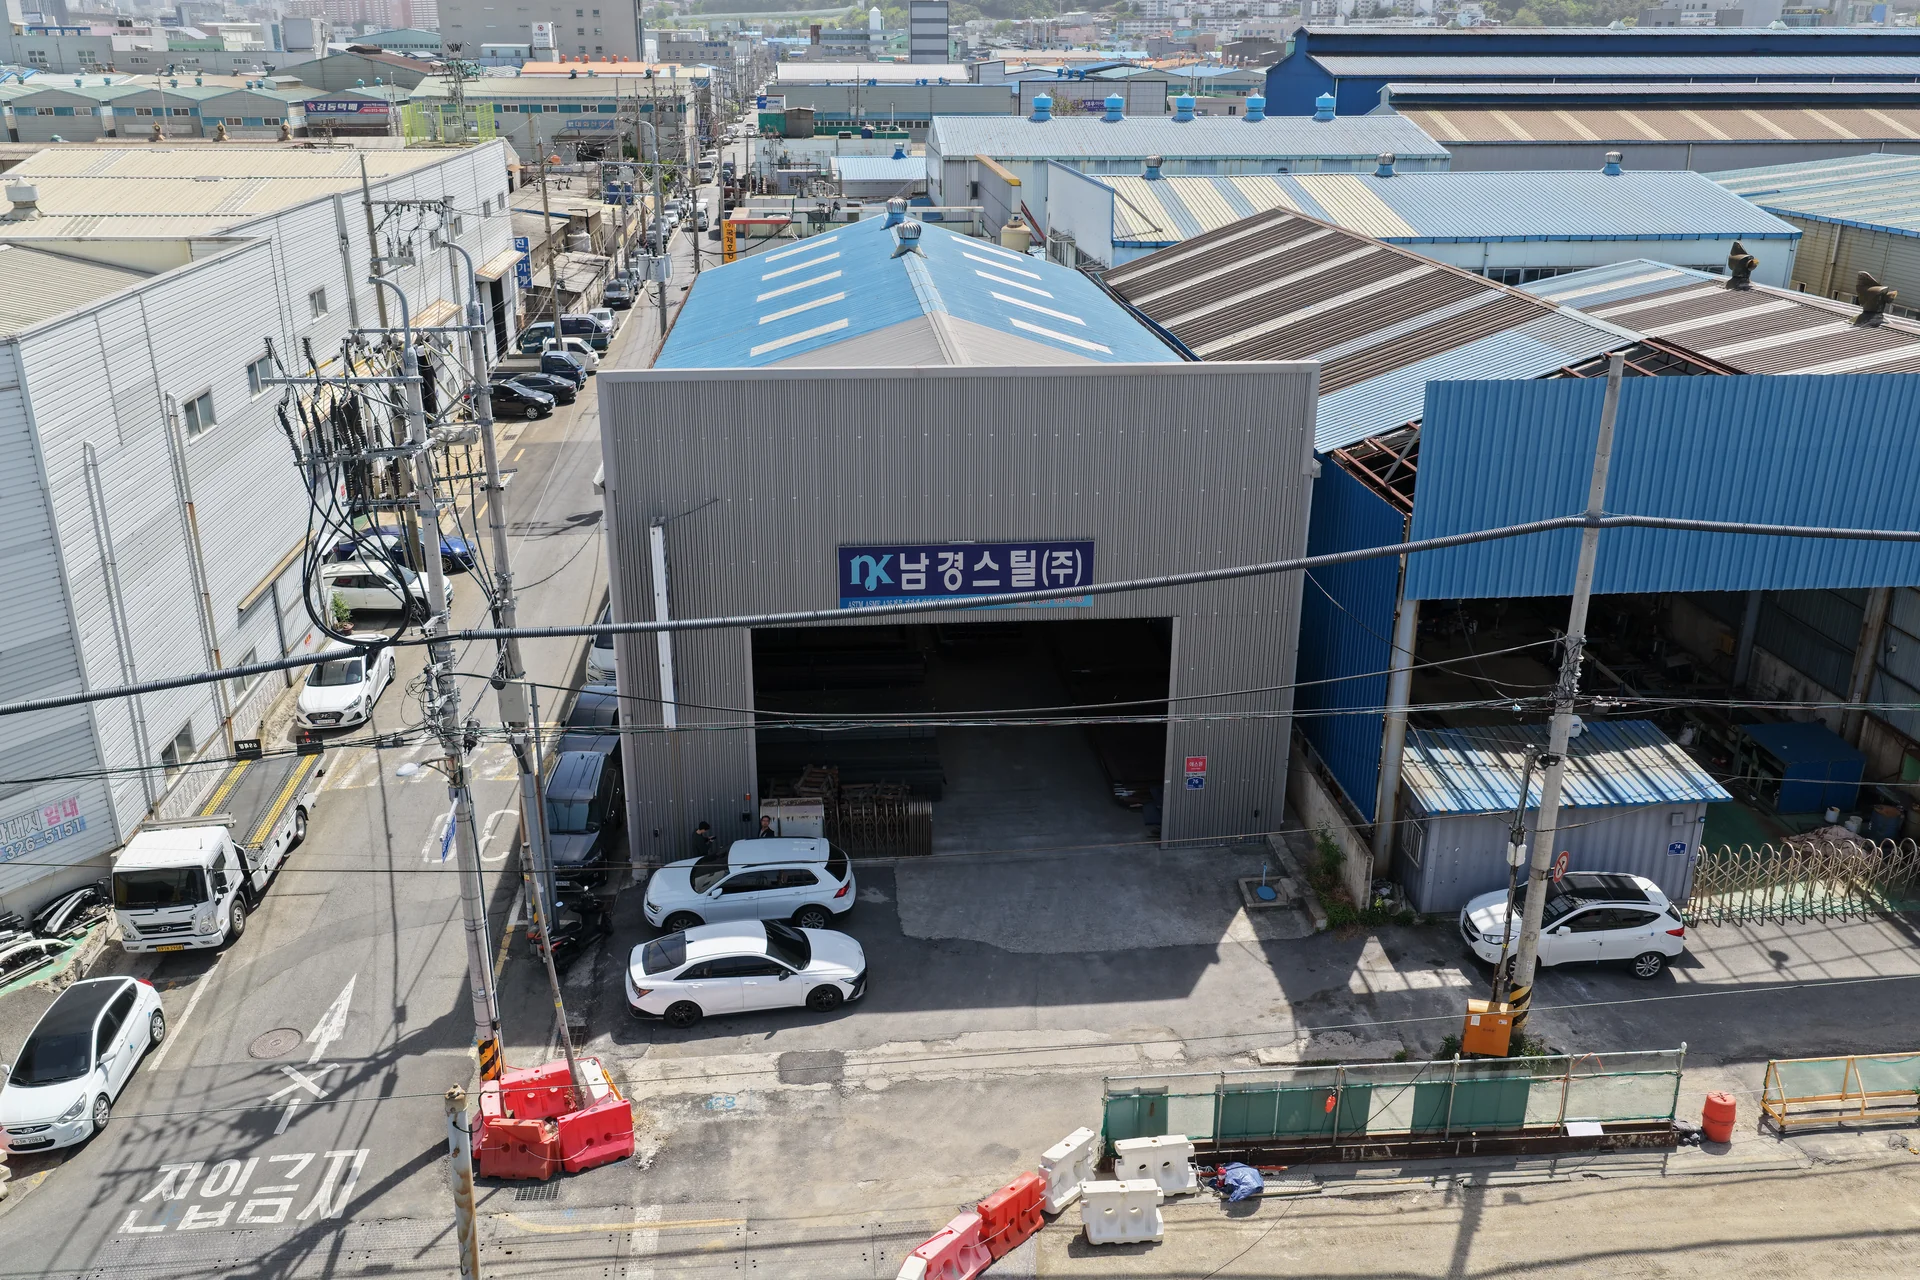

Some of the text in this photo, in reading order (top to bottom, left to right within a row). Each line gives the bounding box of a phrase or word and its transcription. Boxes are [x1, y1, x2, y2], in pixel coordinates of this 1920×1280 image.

[515, 238, 529, 285] 진기계
[899, 548, 1083, 591] 남경스틸(주)
[44, 795, 80, 827] 임대
[5, 817, 82, 861] 326-5151
[118, 1148, 370, 1233] 진입금지
